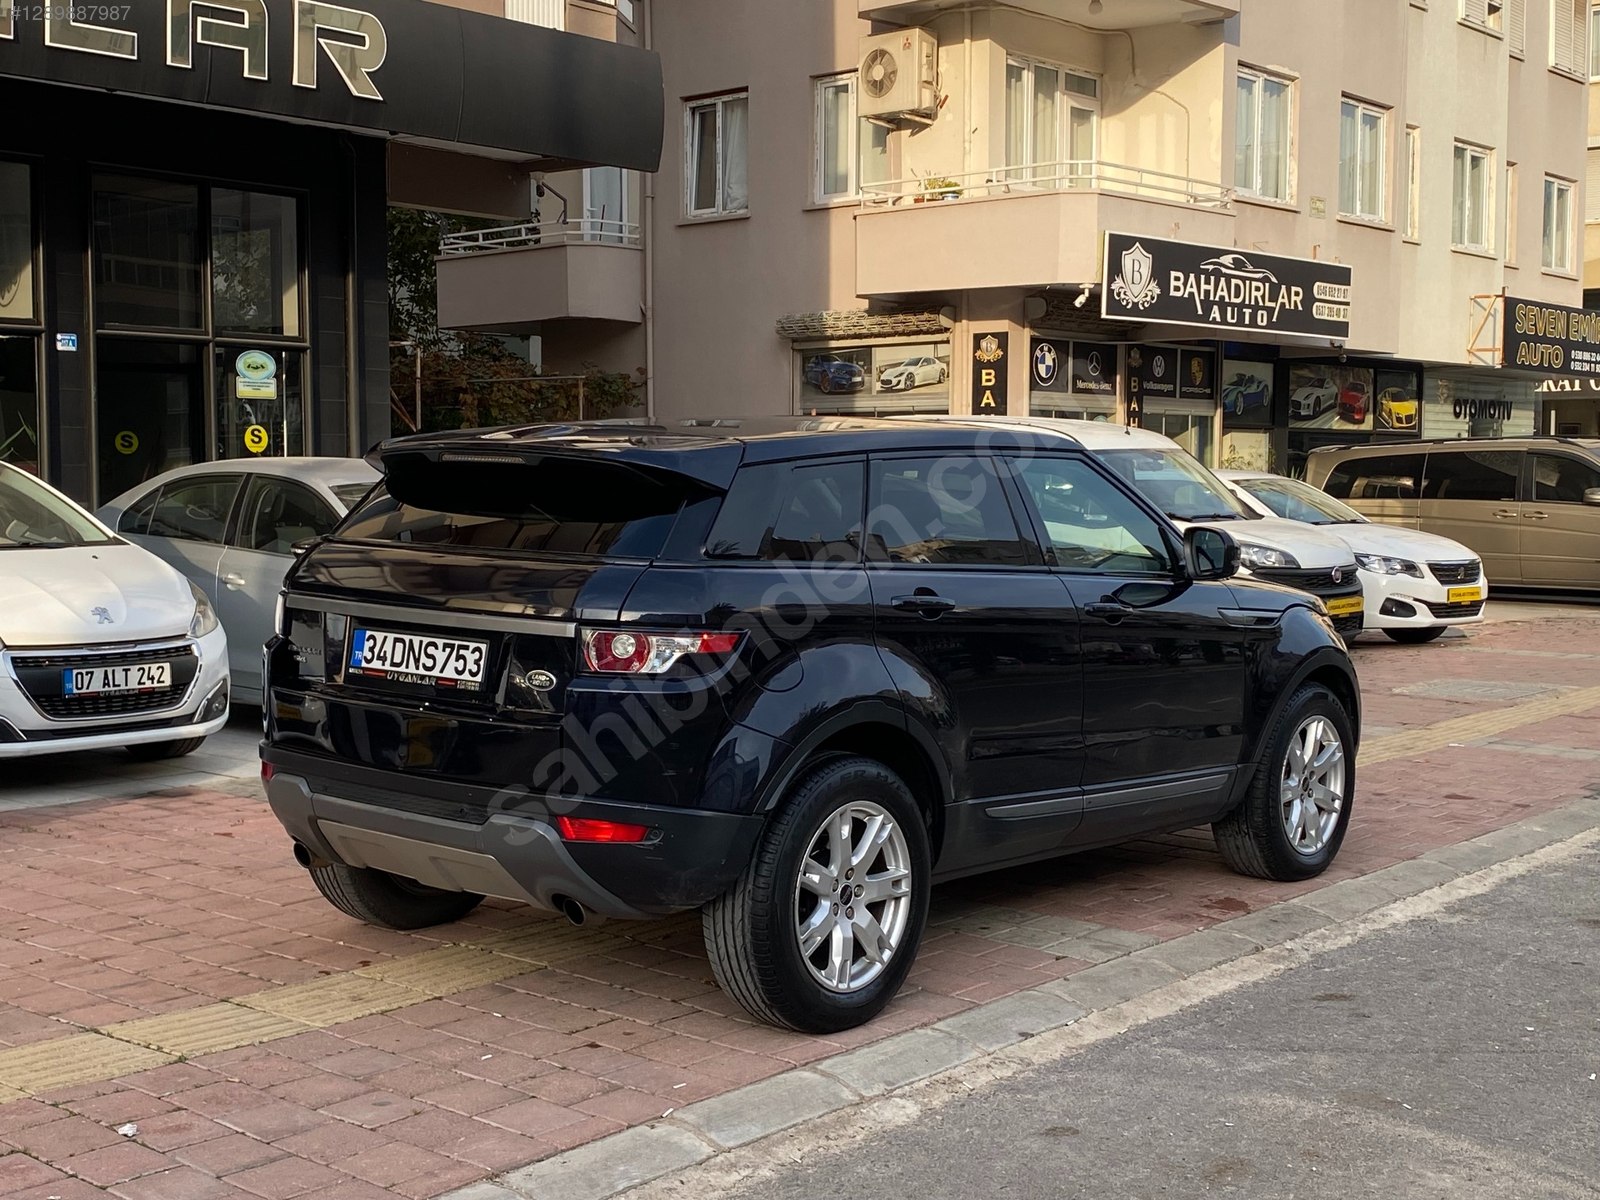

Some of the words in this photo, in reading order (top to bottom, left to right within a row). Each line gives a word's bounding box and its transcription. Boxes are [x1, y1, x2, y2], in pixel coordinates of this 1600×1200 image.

[1169, 269, 1303, 323] BAHADIRLAR
[1209, 304, 1268, 326] AUTO
[1515, 303, 1567, 340] SEVEN
[1516, 341, 1564, 369] AUTO
[980, 368, 996, 416] BA
[250, 428, 263, 445] S
[75, 671, 94, 691] 07
[102, 668, 131, 689] ALT
[137, 665, 166, 686] 242
[386, 671, 437, 686] UYGANLAR
